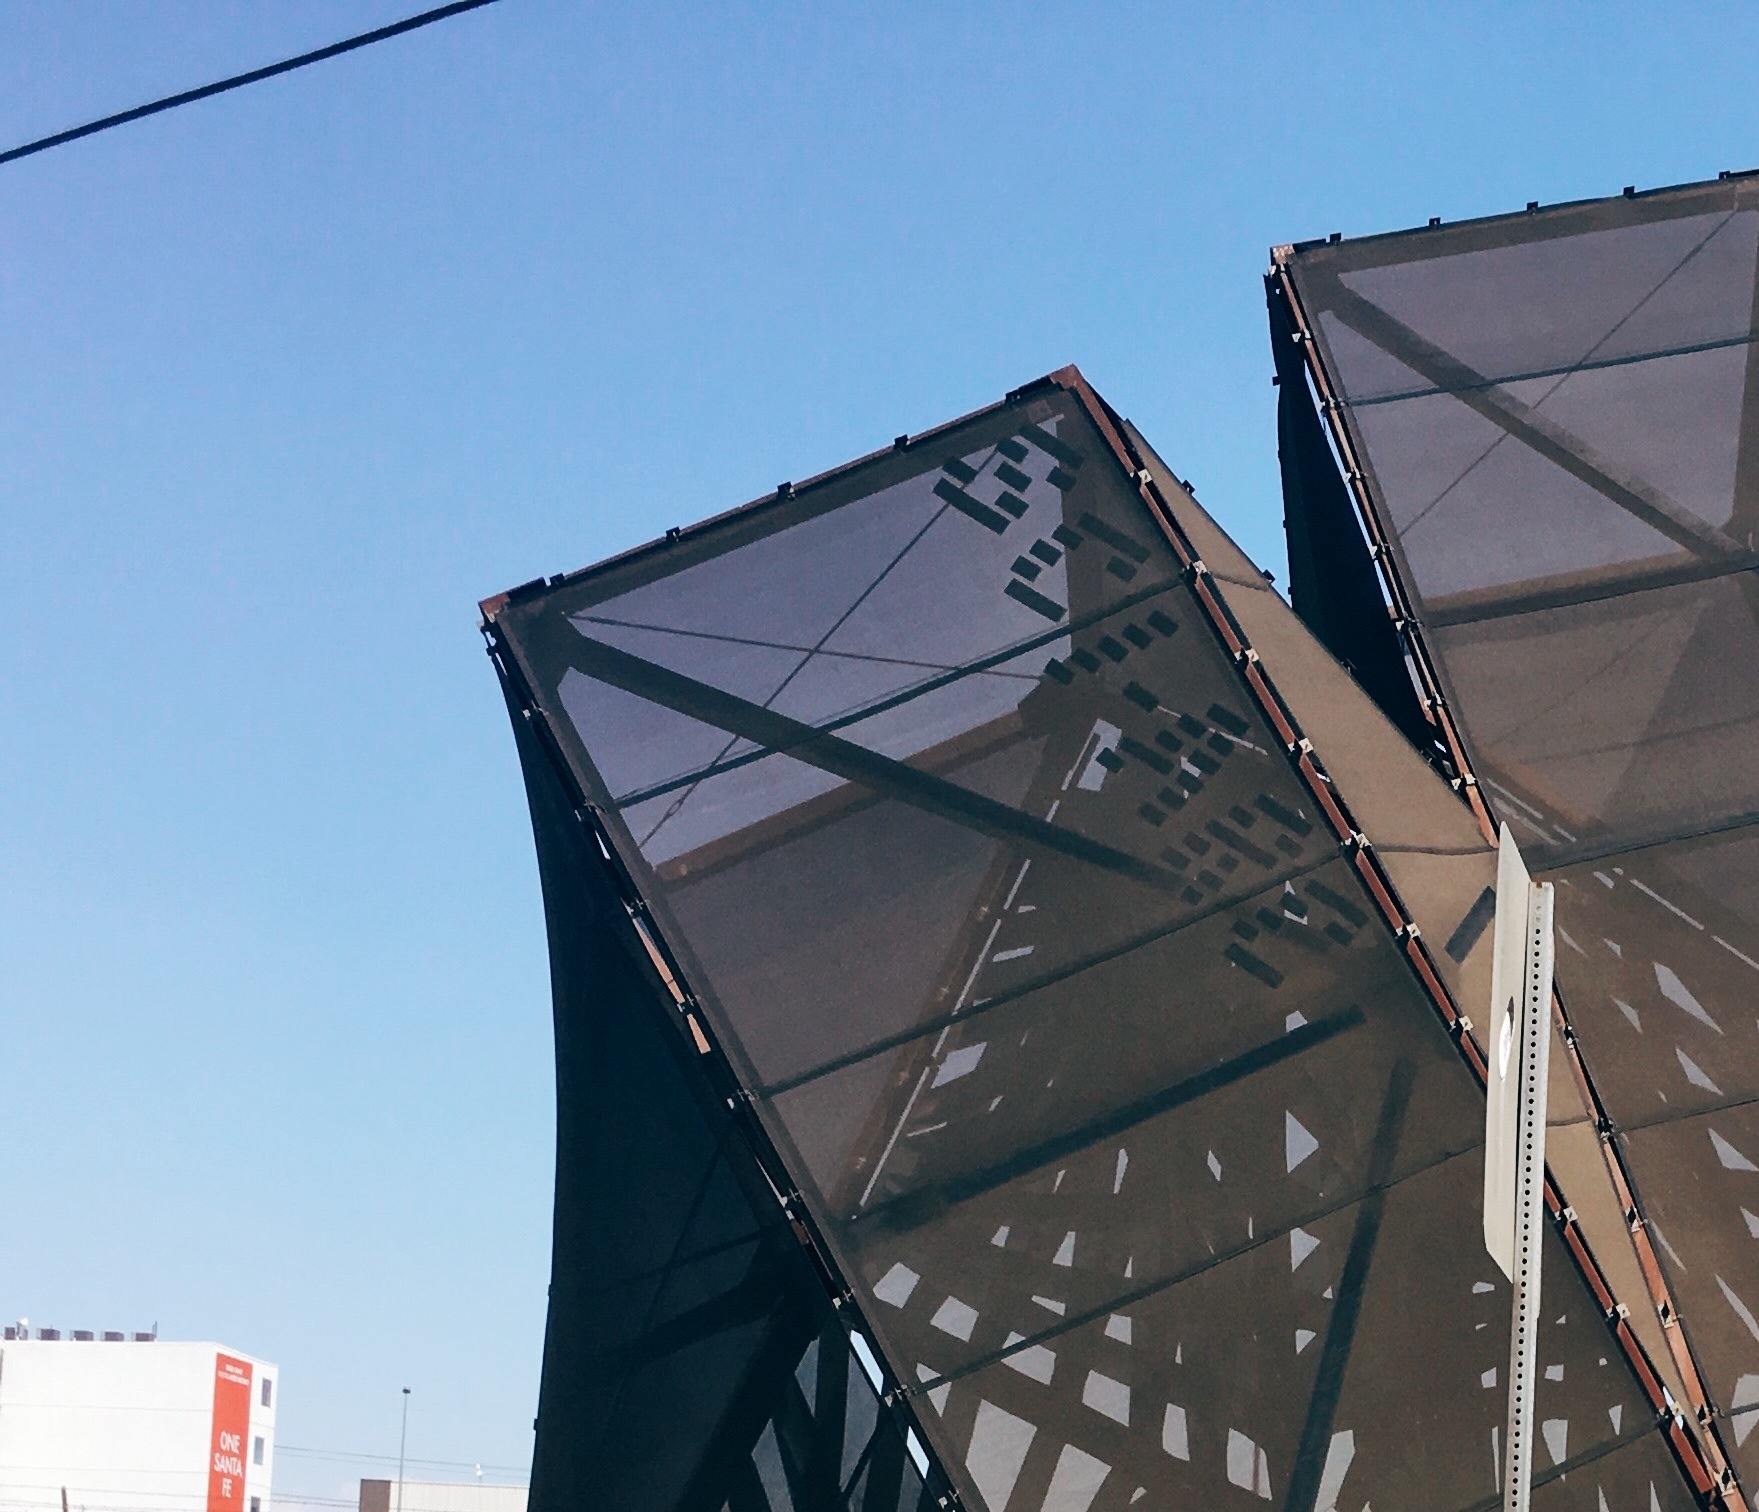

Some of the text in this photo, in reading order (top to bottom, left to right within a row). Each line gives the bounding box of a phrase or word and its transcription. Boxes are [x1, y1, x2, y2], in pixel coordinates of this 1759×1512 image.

[220, 1430, 240, 1455] ONE
[214, 1453, 243, 1477] SANTA
[222, 1477, 232, 1498] FE
